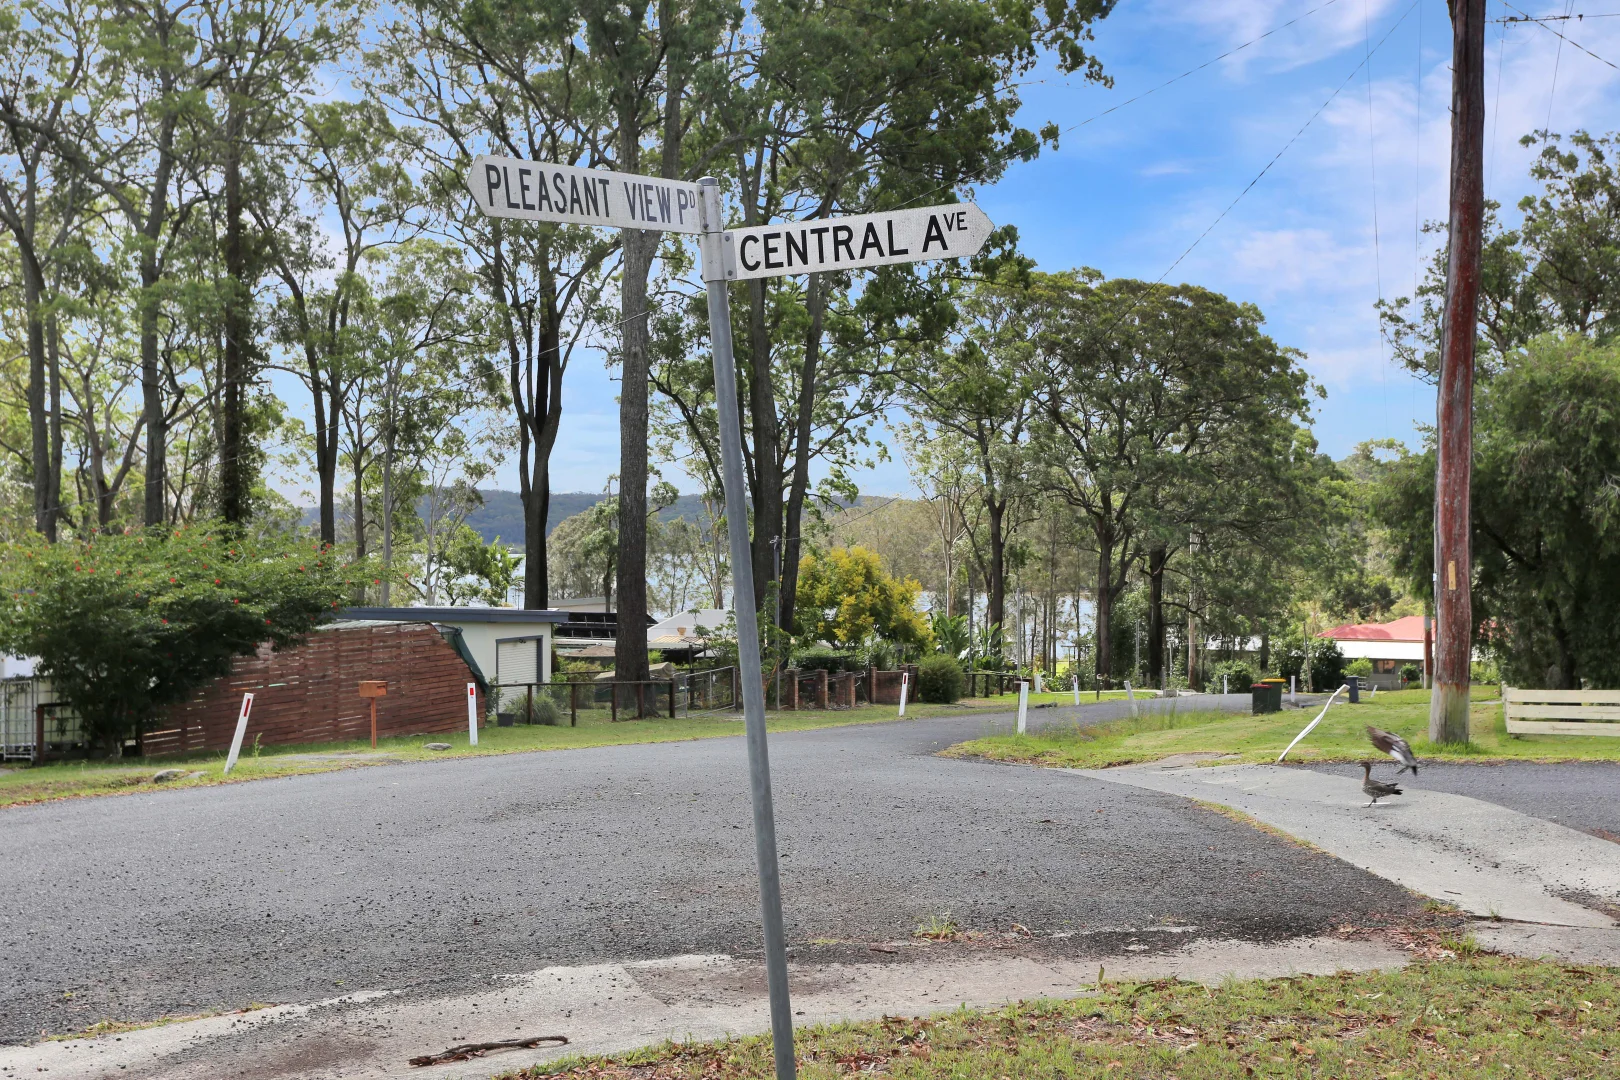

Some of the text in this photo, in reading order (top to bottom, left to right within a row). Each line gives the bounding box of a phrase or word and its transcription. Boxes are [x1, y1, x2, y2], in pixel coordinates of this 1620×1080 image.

[486, 164, 611, 218] PLEASANT
[625, 179, 673, 224] VIEW
[740, 211, 969, 272] CENTRAL AVE
